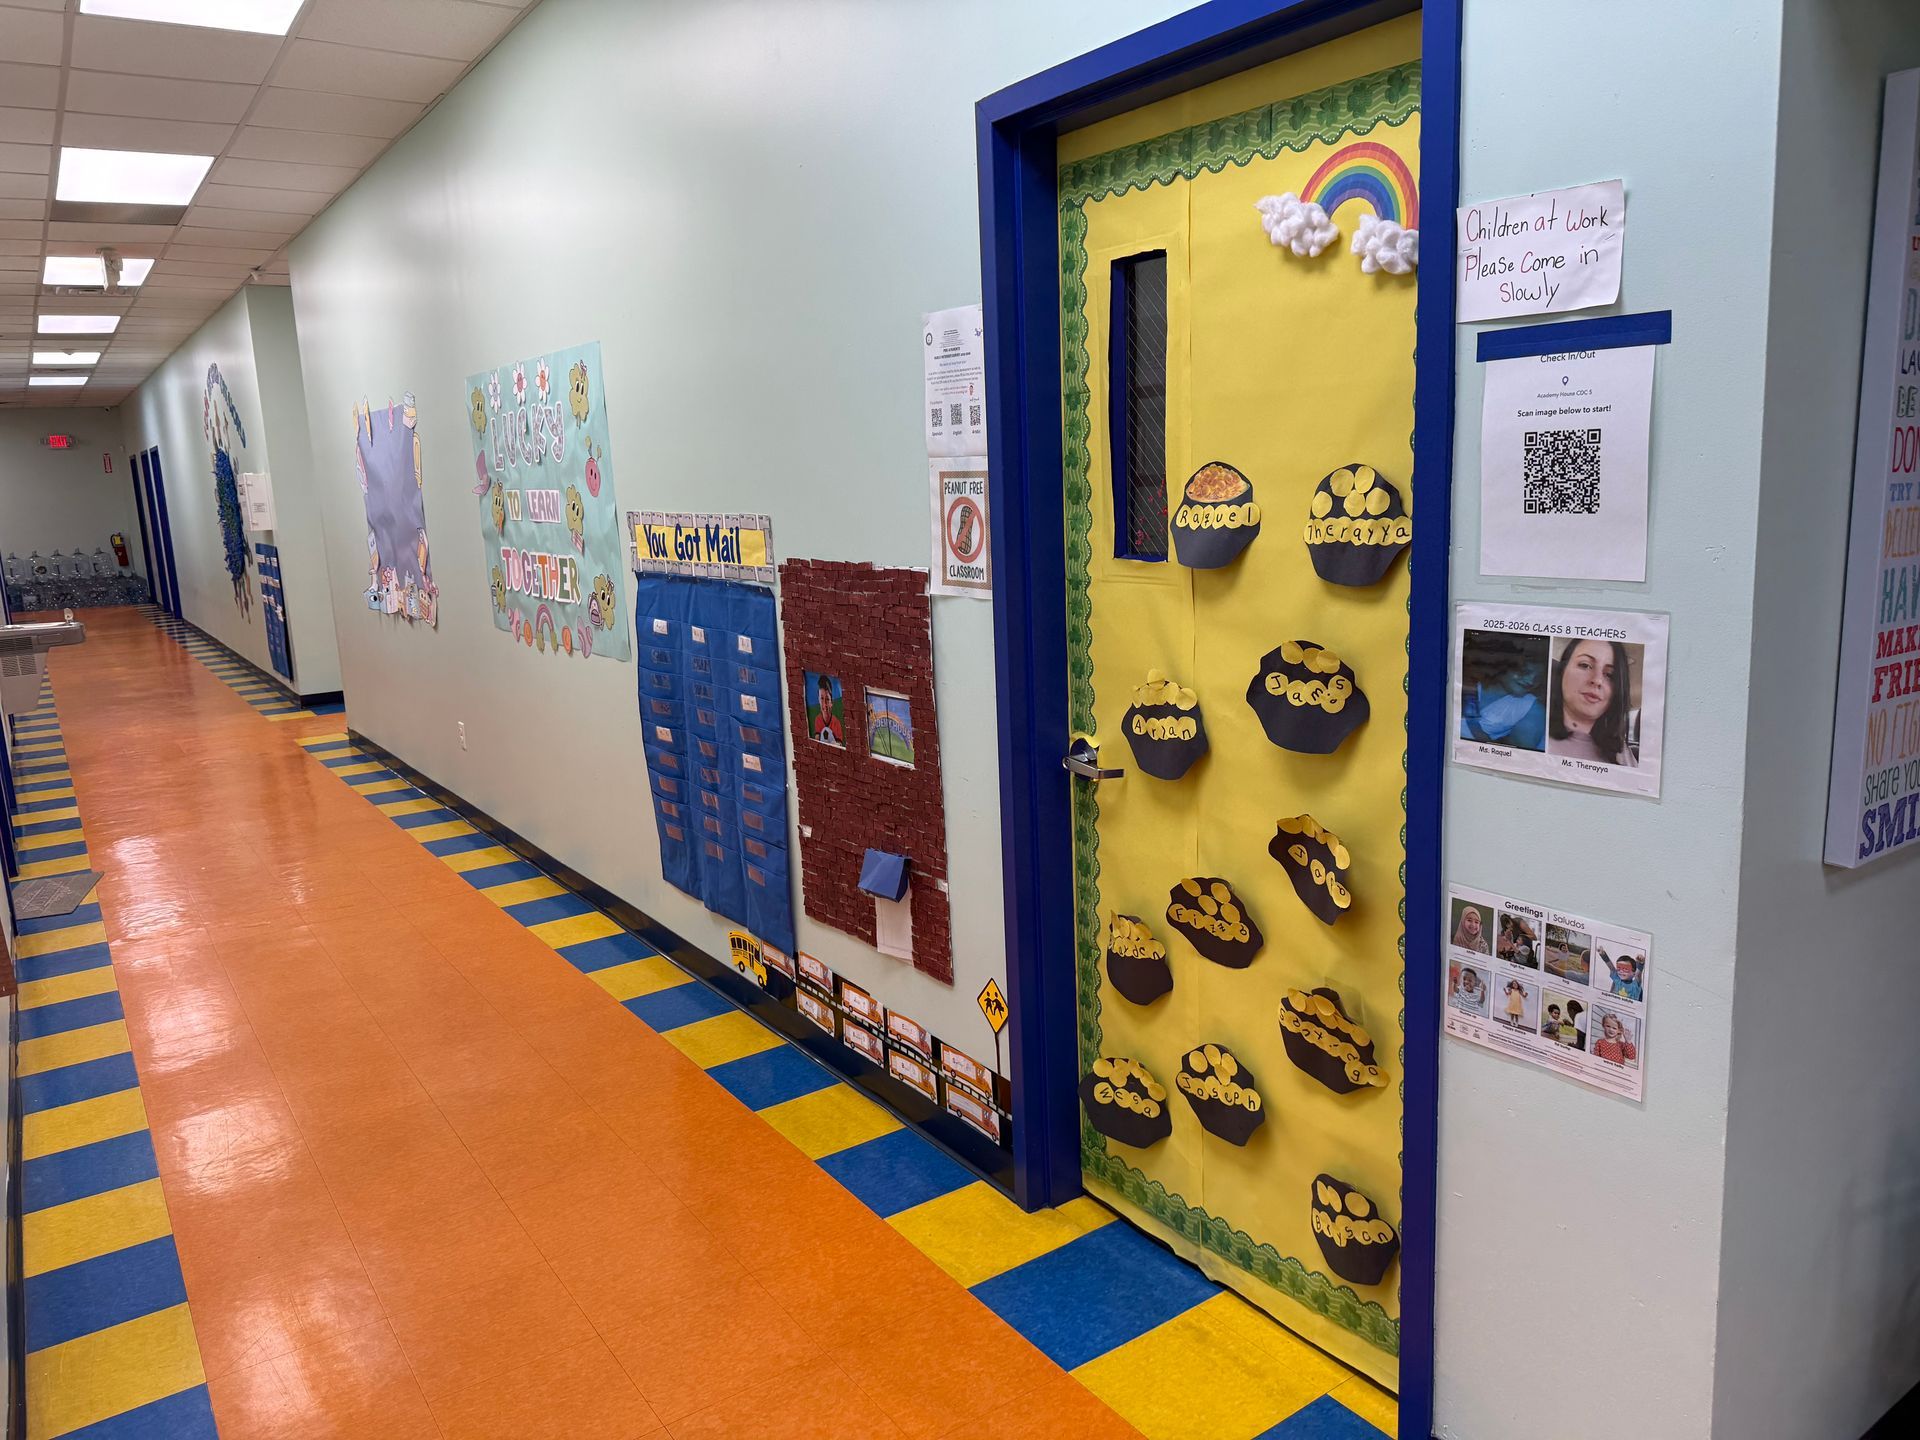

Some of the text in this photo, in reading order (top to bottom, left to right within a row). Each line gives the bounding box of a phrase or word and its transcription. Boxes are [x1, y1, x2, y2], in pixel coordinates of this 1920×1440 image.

[1466, 198, 1608, 242] Children at Work
[1464, 245, 1598, 282] Please Come in
[1500, 272, 1560, 308] Slowly
[1540, 350, 1596, 363] Check In/Out
[1517, 409, 1534, 417] Scan
[1535, 408, 1557, 418] image
[1558, 406, 1582, 415] below
[1592, 405, 1612, 413] start!
[490, 401, 565, 471] LUCKY
[944, 481, 983, 495] PEANUT FREE
[1890, 482, 1914, 502] TRY
[507, 490, 560, 522] TO LEARN
[1180, 506, 1251, 526] Raquel
[644, 523, 741, 564] You Got Mail
[1308, 524, 1410, 543] Therayya
[501, 546, 582, 605] TOGETHER
[950, 565, 984, 580] CLASSROOM
[1483, 619, 1627, 639] 2025-2026 CLASS 8 TEACHERS
[1866, 700, 1920, 769] NO FIG
[1576, 761, 1608, 773] Therayya
[1859, 792, 1920, 860] SMI
[1504, 901, 1585, 930] Greetings Saludos
[1182, 1077, 1256, 1110] Joseph
